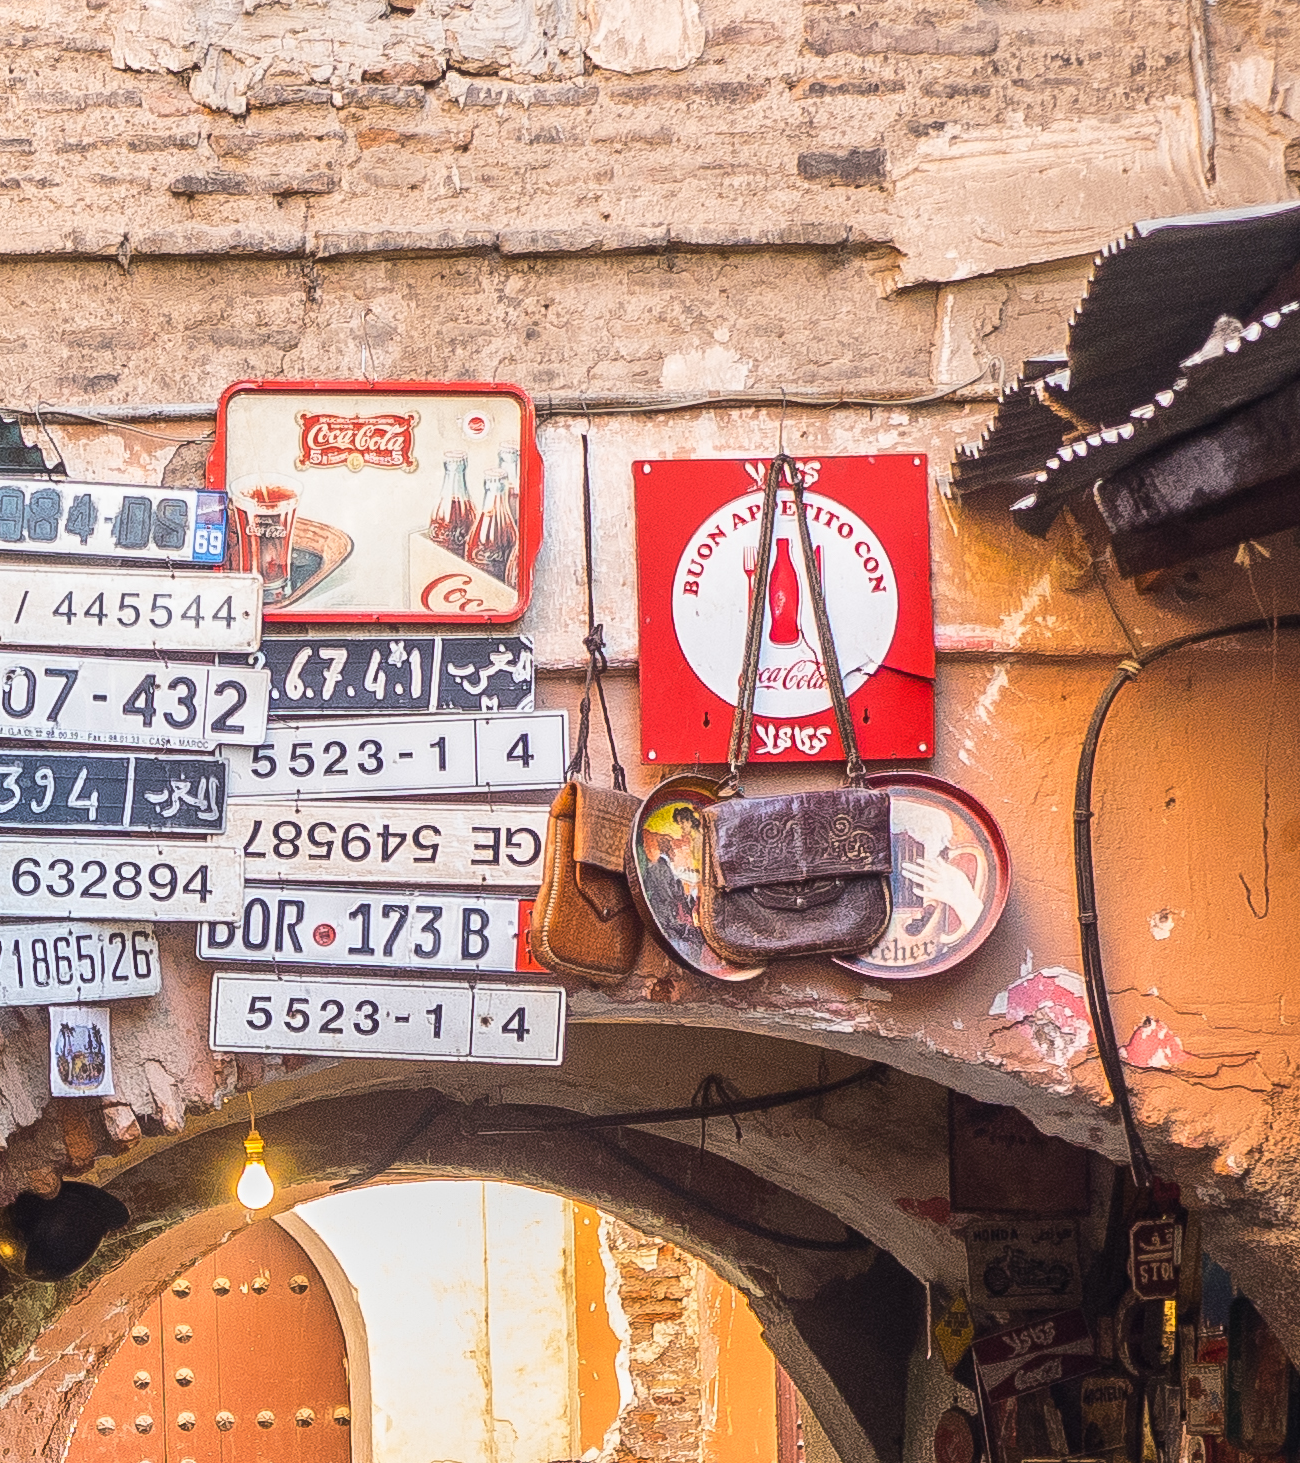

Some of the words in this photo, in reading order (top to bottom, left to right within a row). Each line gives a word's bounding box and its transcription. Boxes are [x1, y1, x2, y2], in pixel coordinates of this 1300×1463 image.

[307, 423, 408, 451] Coca-Cola
[194, 529, 223, 555] 69
[683, 525, 726, 597] BUON
[731, 500, 854, 540] APETITO
[854, 541, 887, 594] CON
[52, 590, 237, 630] 445544
[210, 680, 248, 735] 2
[506, 732, 535, 769] 4
[244, 819, 442, 865] 549587
[470, 825, 543, 867] GE
[11, 857, 213, 904] 632894
[500, 1006, 531, 1043] 4
